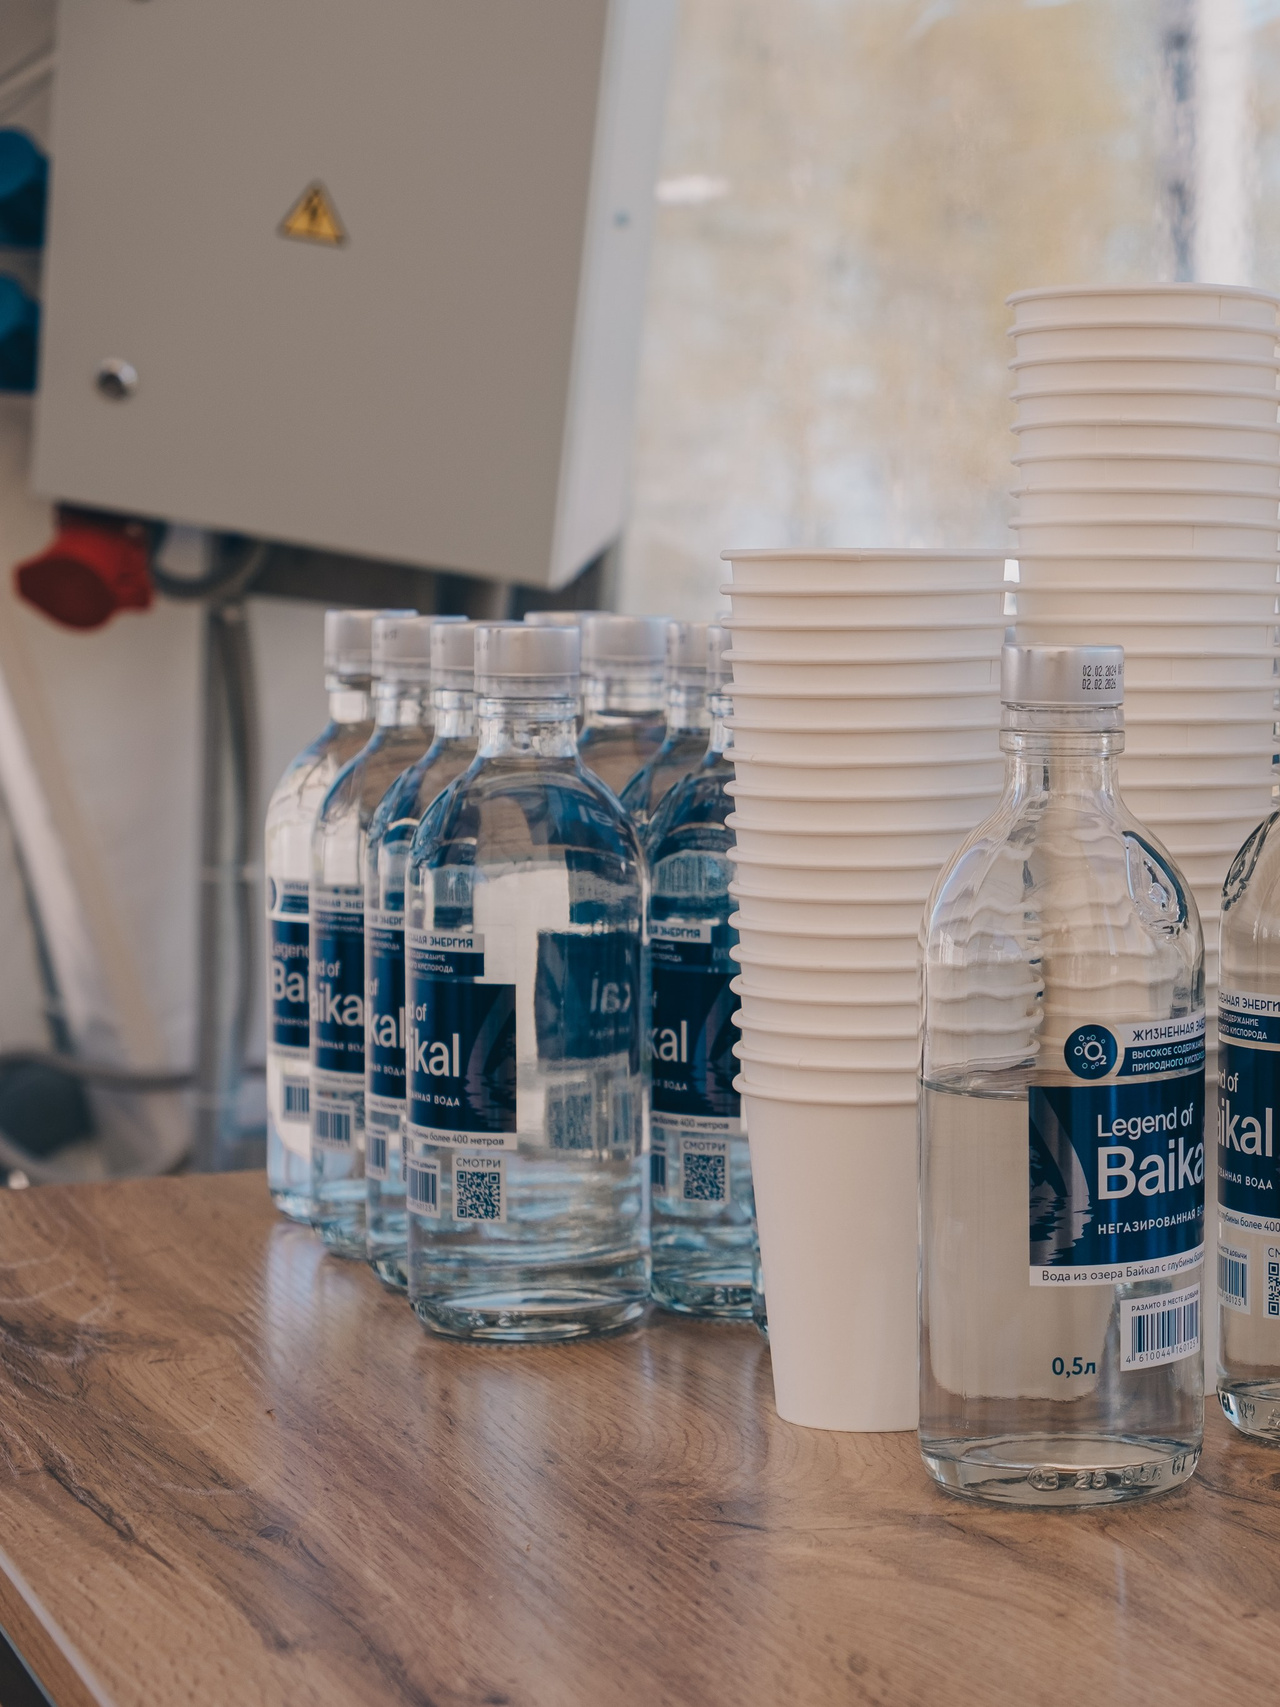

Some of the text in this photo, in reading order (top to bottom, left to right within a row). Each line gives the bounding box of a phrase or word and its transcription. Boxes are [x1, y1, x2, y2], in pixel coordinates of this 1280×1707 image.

[430, 937, 473, 949] ЭНЕРГИЯ
[415, 1003, 427, 1022] of
[1132, 1022, 1195, 1042] ЖИЗНЕННАЯ
[1230, 1028, 1268, 1040] КИСЛОРОДА
[1132, 1046, 1172, 1060] ВЫСОКОЕ
[1132, 1057, 1183, 1072] ПРИРОДНОГО
[664, 1080, 688, 1091] ВОДА
[1227, 1072, 1239, 1093] of
[433, 1095, 460, 1107] ВОДА
[696, 1122, 729, 1131] метров
[1097, 1102, 1194, 1140] Legend of
[430, 1132, 504, 1147] более 400 метров
[683, 1140, 726, 1151] СМОТРИ
[456, 1158, 501, 1168] СМОТРИ
[1245, 1177, 1273, 1190] ВОДА
[1098, 1208, 1196, 1235] НЕГАЗИРОВАННАЯ
[1240, 1217, 1262, 1230] более
[1264, 1221, 1280, 1233] 400
[1042, 1255, 1194, 1282] Вода из озера Байкал с глубины
[1131, 1302, 1161, 1312] РАЗЛИТО
[1168, 1295, 1183, 1306] МЕСТЕ
[1125, 1340, 1196, 1363] 4 610044 160125
[1052, 1357, 1096, 1379] 0,5л
